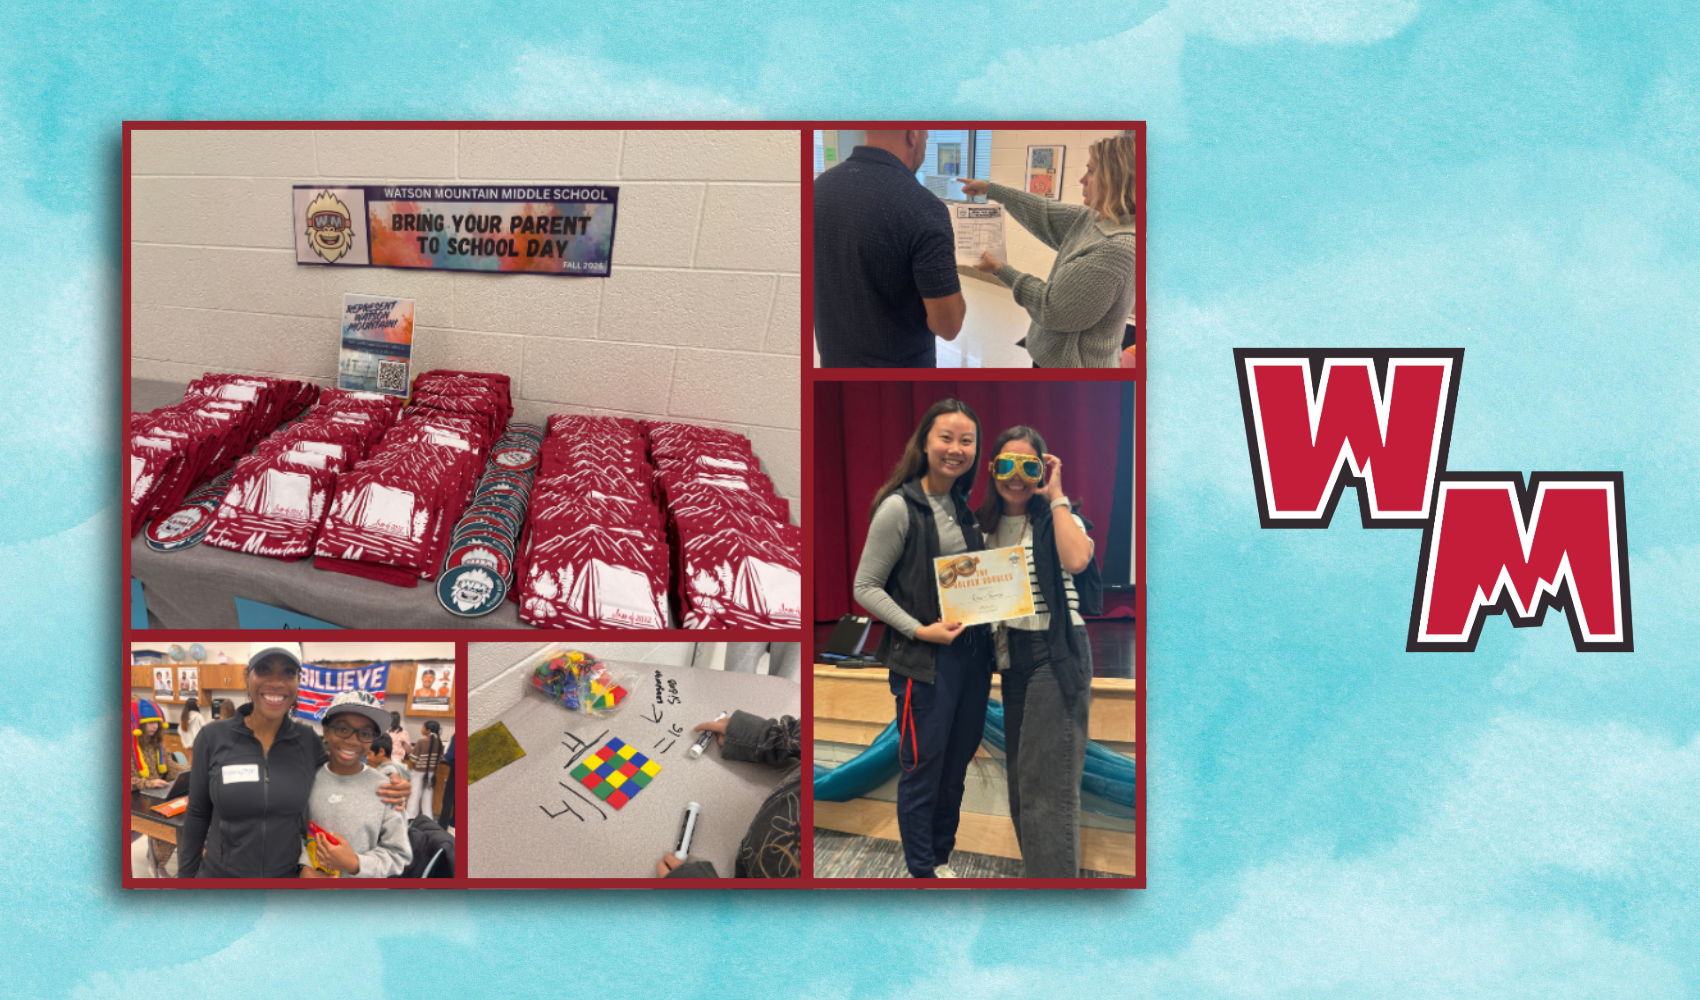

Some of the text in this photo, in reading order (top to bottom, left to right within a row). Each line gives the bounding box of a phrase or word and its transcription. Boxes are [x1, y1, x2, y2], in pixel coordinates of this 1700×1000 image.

[384, 188, 608, 201] WATSON MOUNTAIN MIDDLE SCHOOL
[392, 213, 591, 235] BRING YOUR PARENT
[417, 236, 569, 259] TO SCHOOL DAY
[562, 261, 582, 270] FALL
[346, 300, 397, 314] REPRESENT
[300, 665, 386, 690] BILLIEVE
